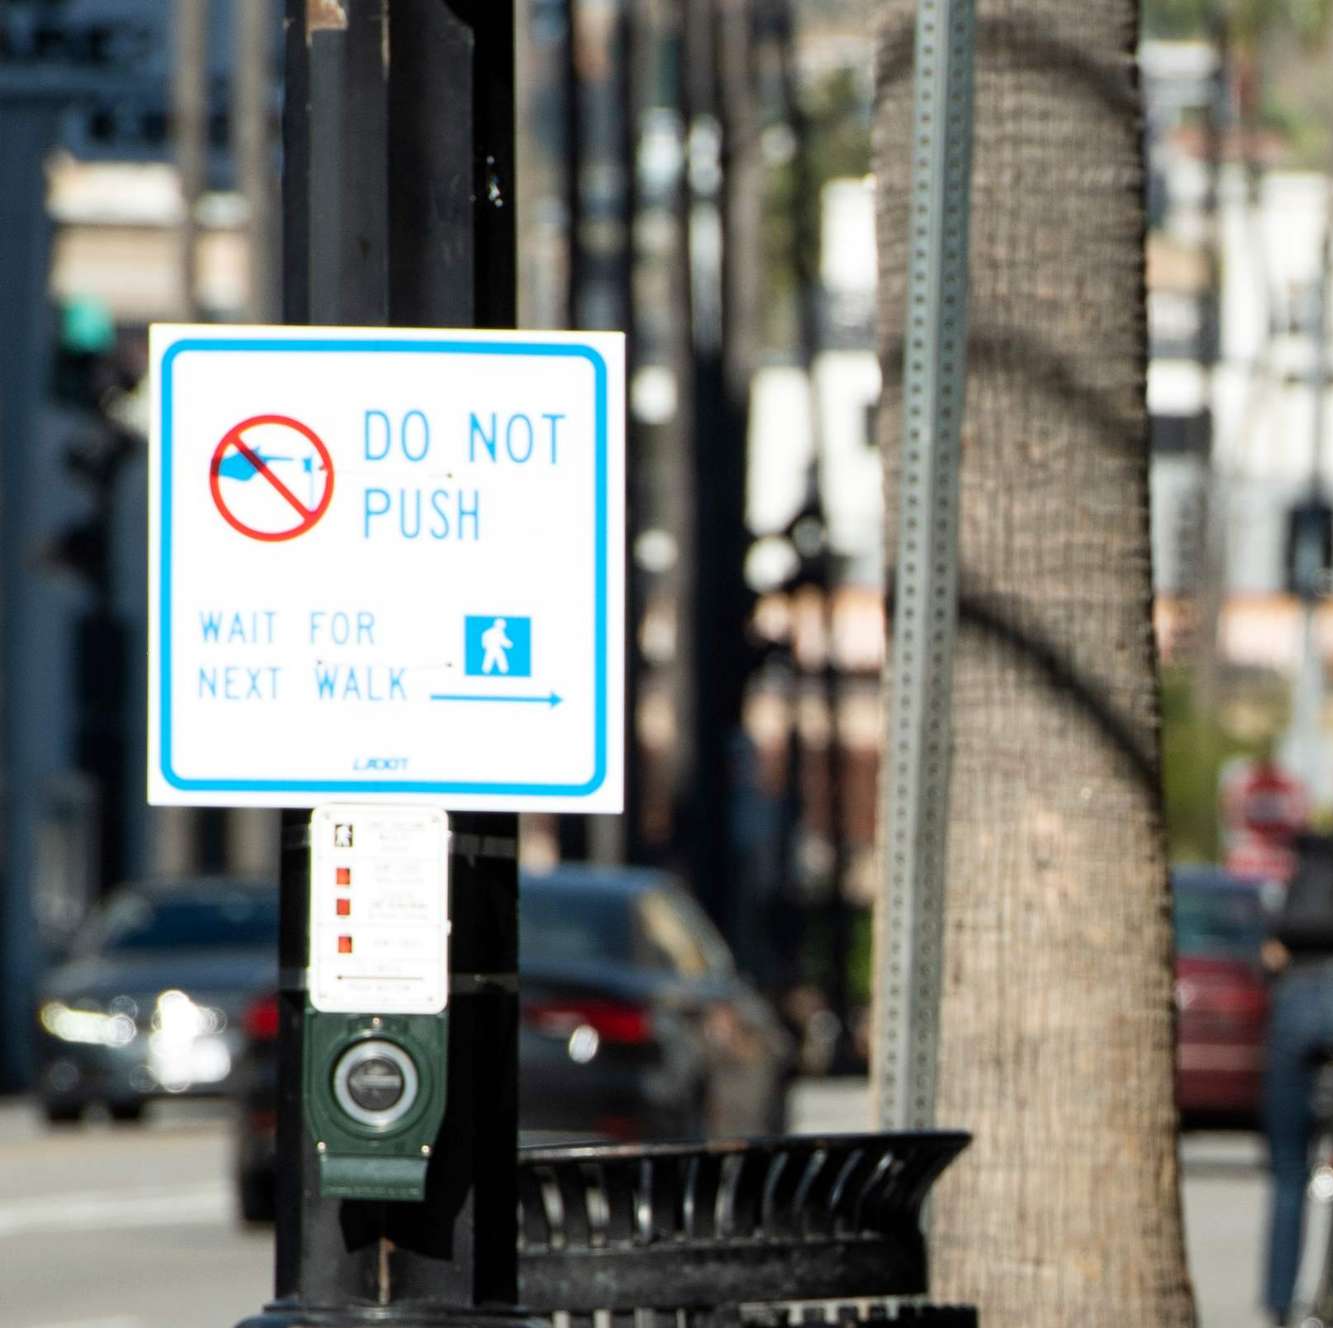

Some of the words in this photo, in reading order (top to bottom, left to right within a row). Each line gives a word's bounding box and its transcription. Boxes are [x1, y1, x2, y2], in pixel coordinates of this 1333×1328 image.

[363, 409, 431, 462] DO
[468, 411, 566, 465] NOT
[363, 487, 481, 541] PUSH
[199, 611, 276, 645] WAIT
[309, 610, 376, 647] FOR
[197, 666, 282, 701] NEXT
[314, 667, 408, 701] WALK
